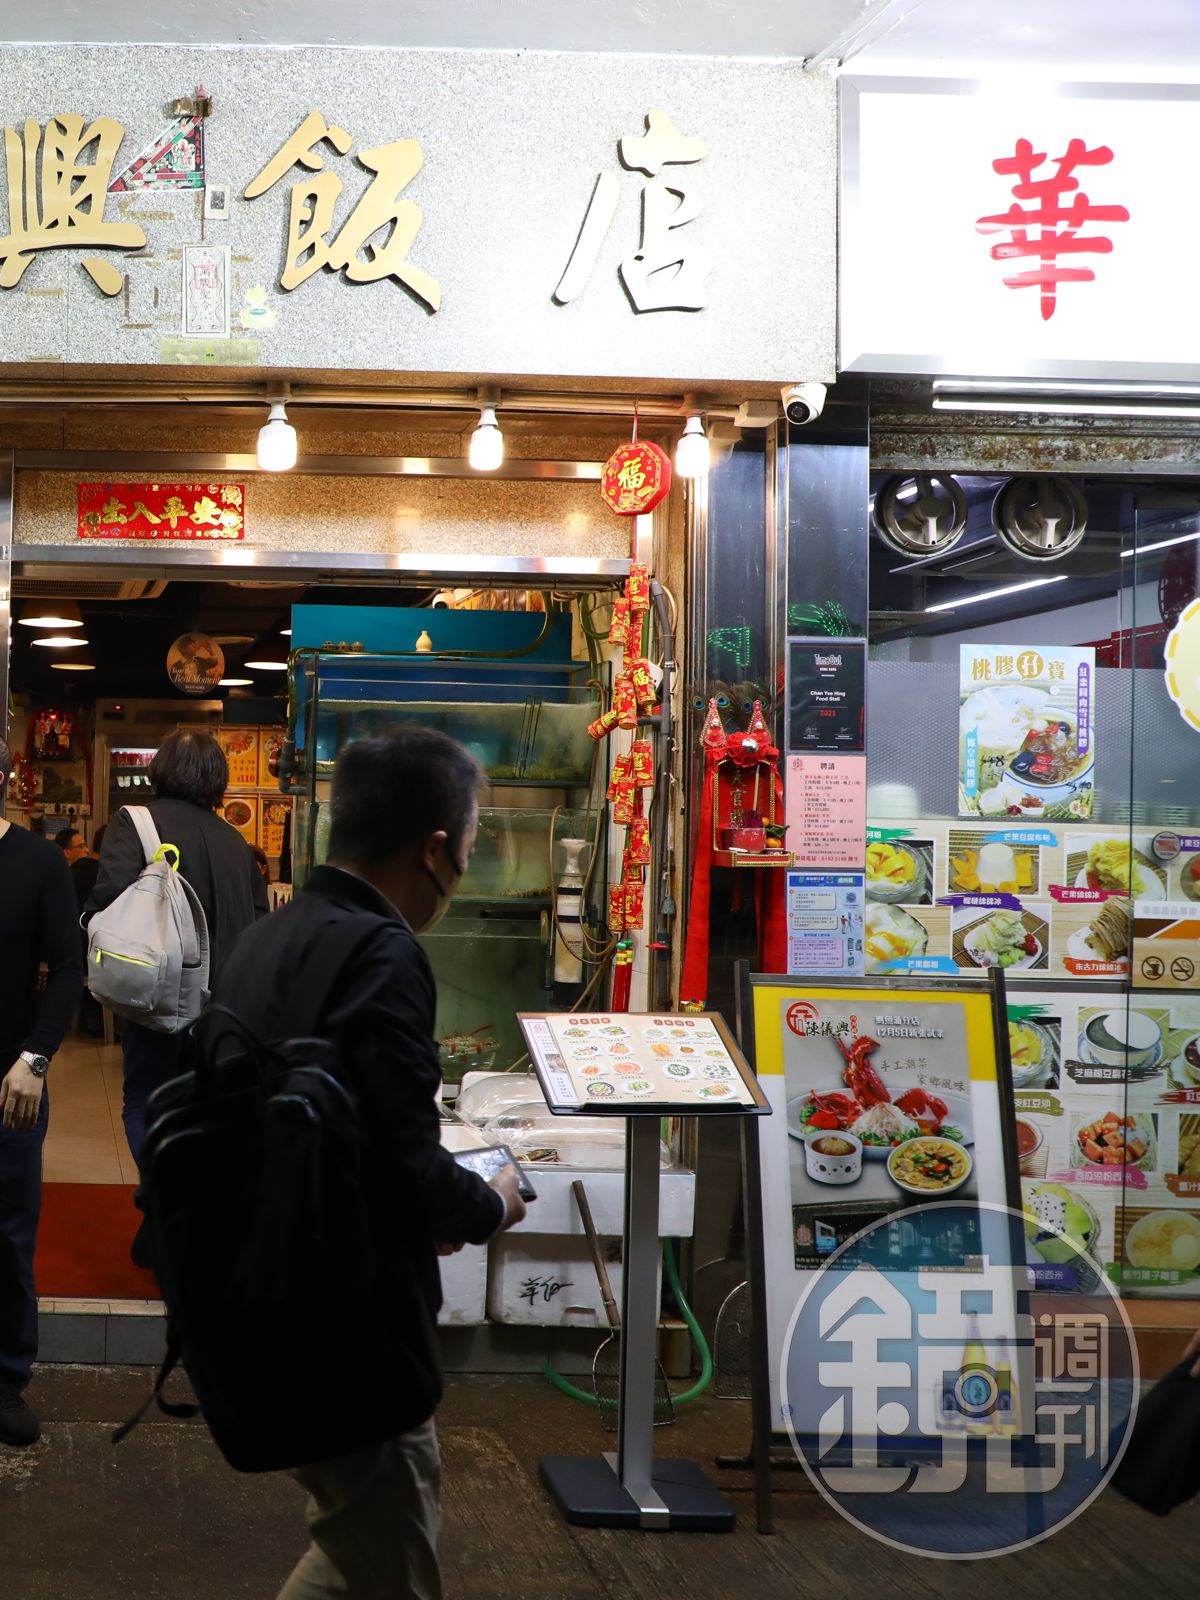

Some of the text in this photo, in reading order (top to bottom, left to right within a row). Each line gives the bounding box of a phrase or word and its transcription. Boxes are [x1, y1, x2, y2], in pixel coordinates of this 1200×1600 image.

[974, 138, 1130, 321] 華
[617, 457, 646, 490] 福
[102, 496, 222, 530] 出入平安
[805, 1021, 851, 1037] 陳儀興
